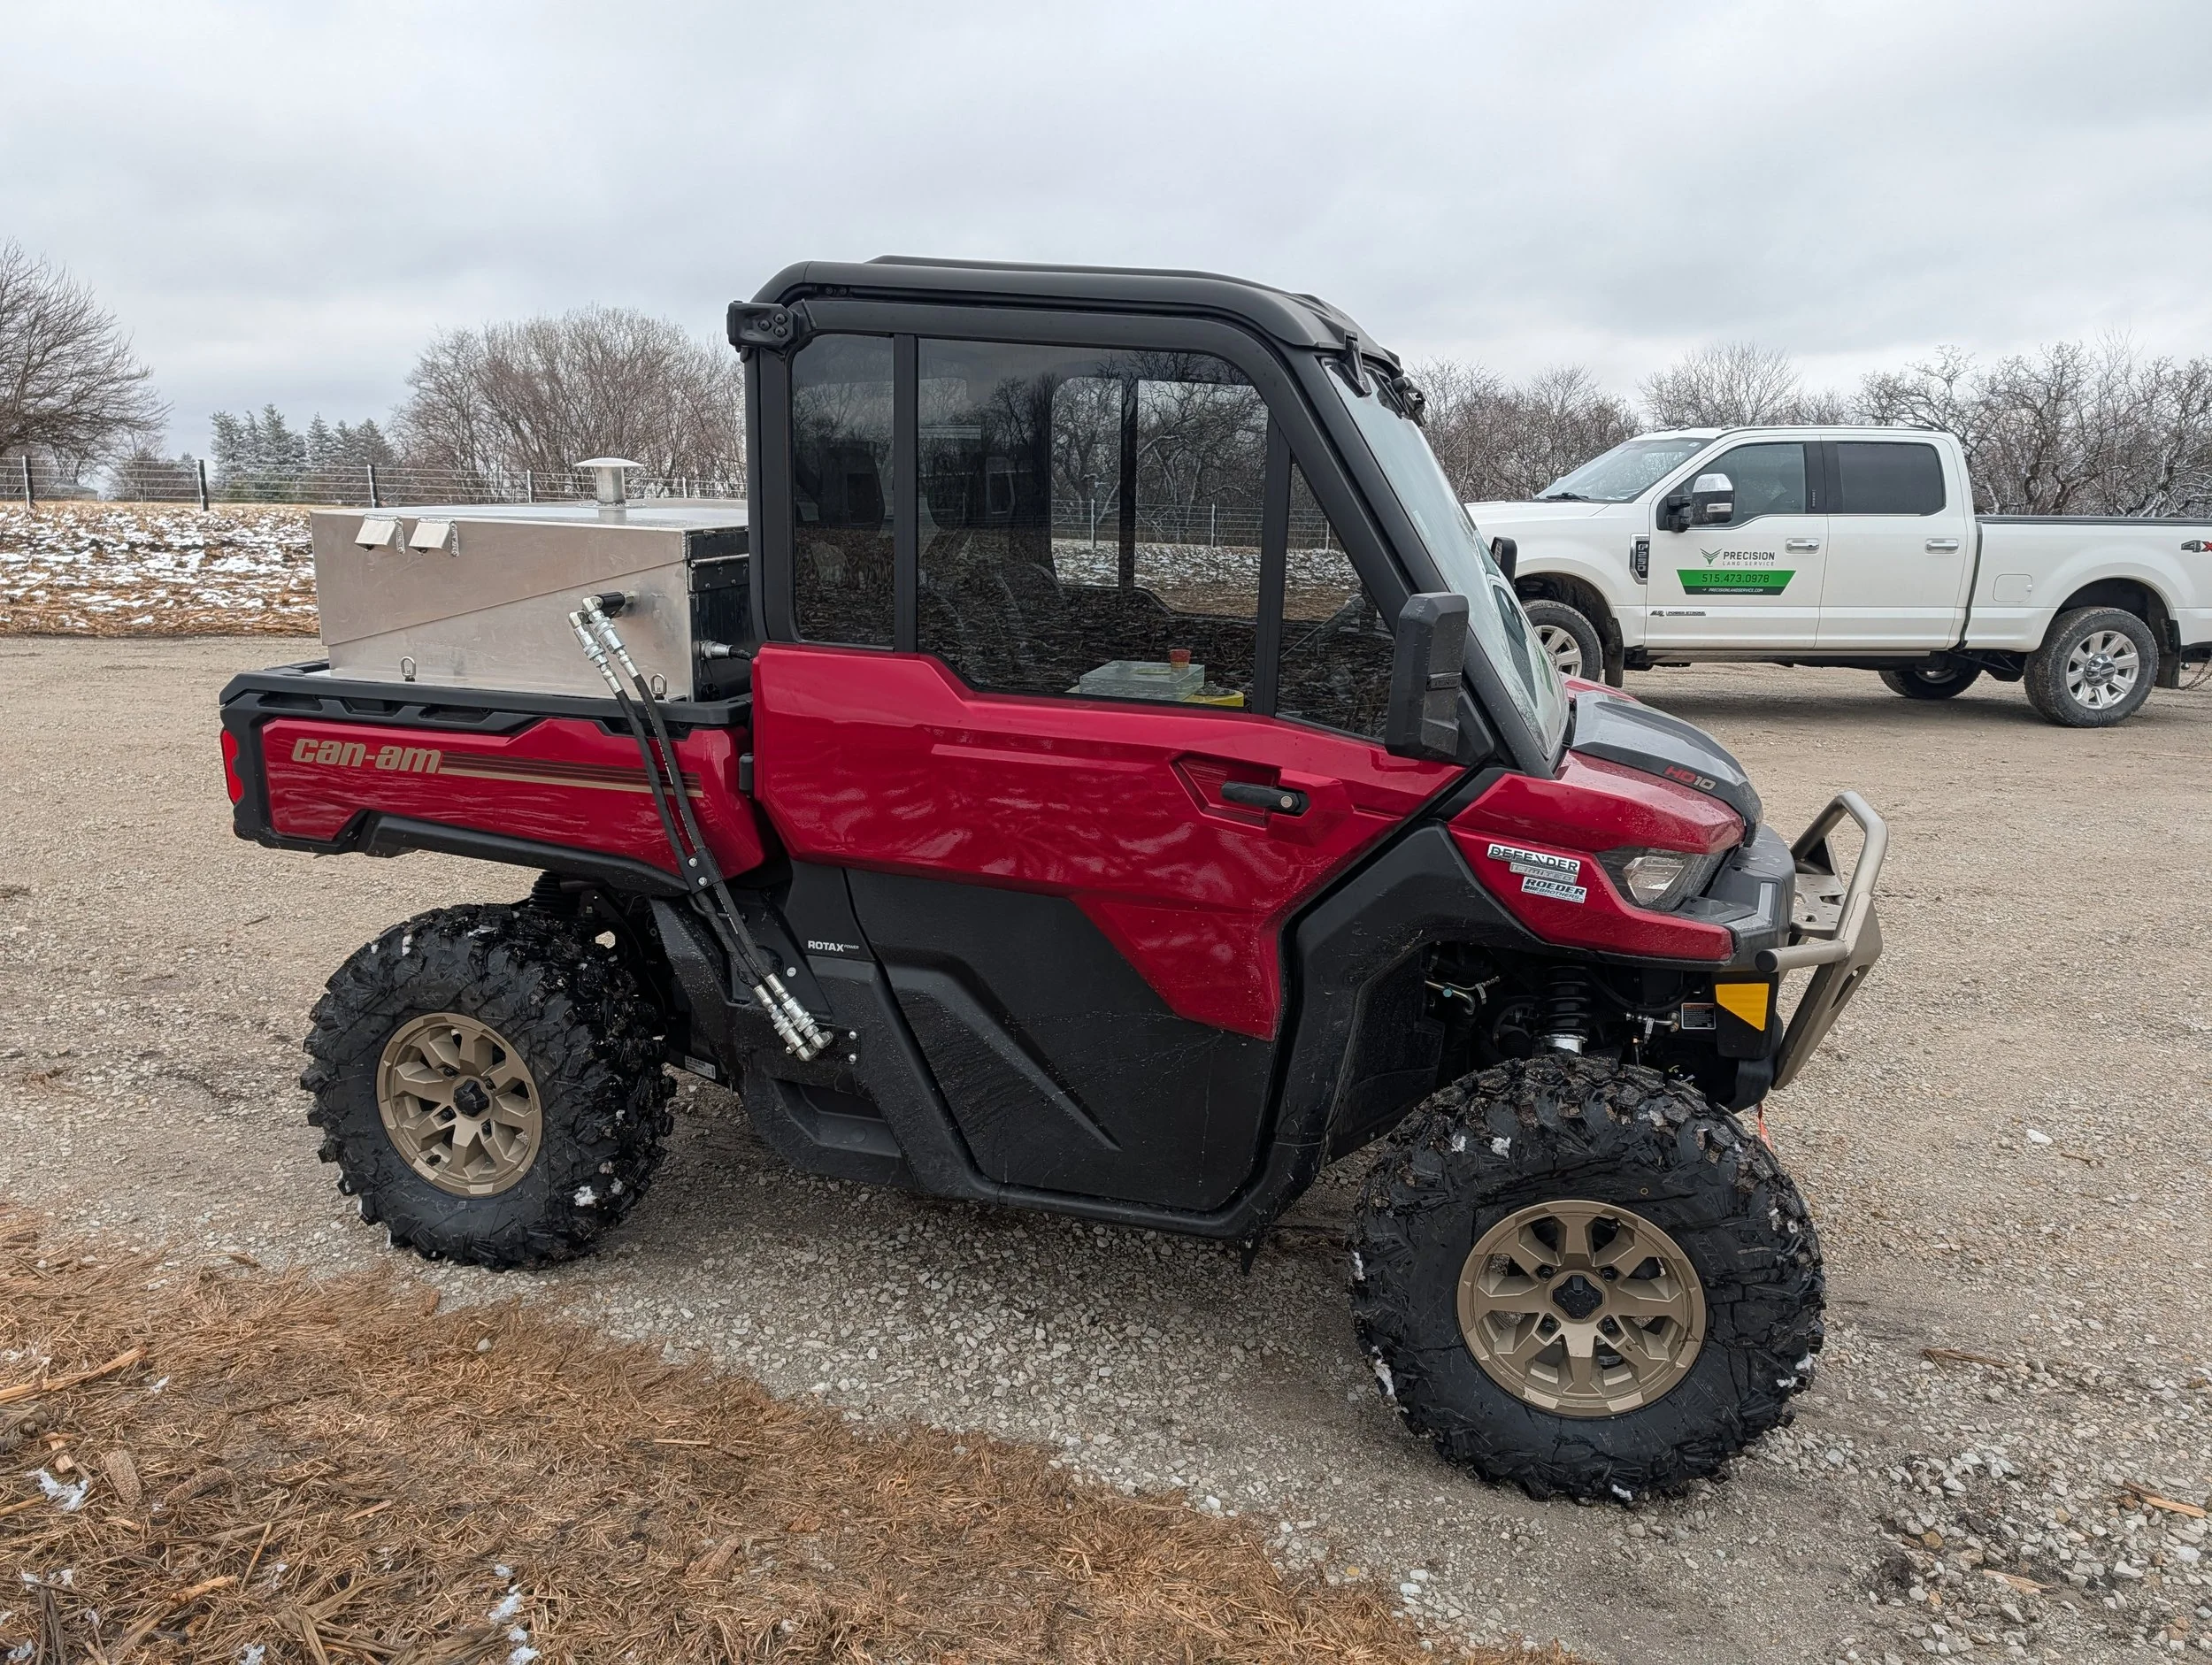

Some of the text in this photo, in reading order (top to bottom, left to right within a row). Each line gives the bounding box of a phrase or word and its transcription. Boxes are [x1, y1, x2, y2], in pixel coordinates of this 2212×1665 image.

[1723, 551, 1775, 560] PRECISION
[1701, 573, 1770, 583] 515.473.0978
[1664, 765, 1717, 790] HD10
[1489, 846, 1578, 871] DEFENDER
[1525, 879, 1586, 895] ROEDER
[1540, 887, 1580, 900] BROTHERS
[808, 940, 844, 952] ROTAX
